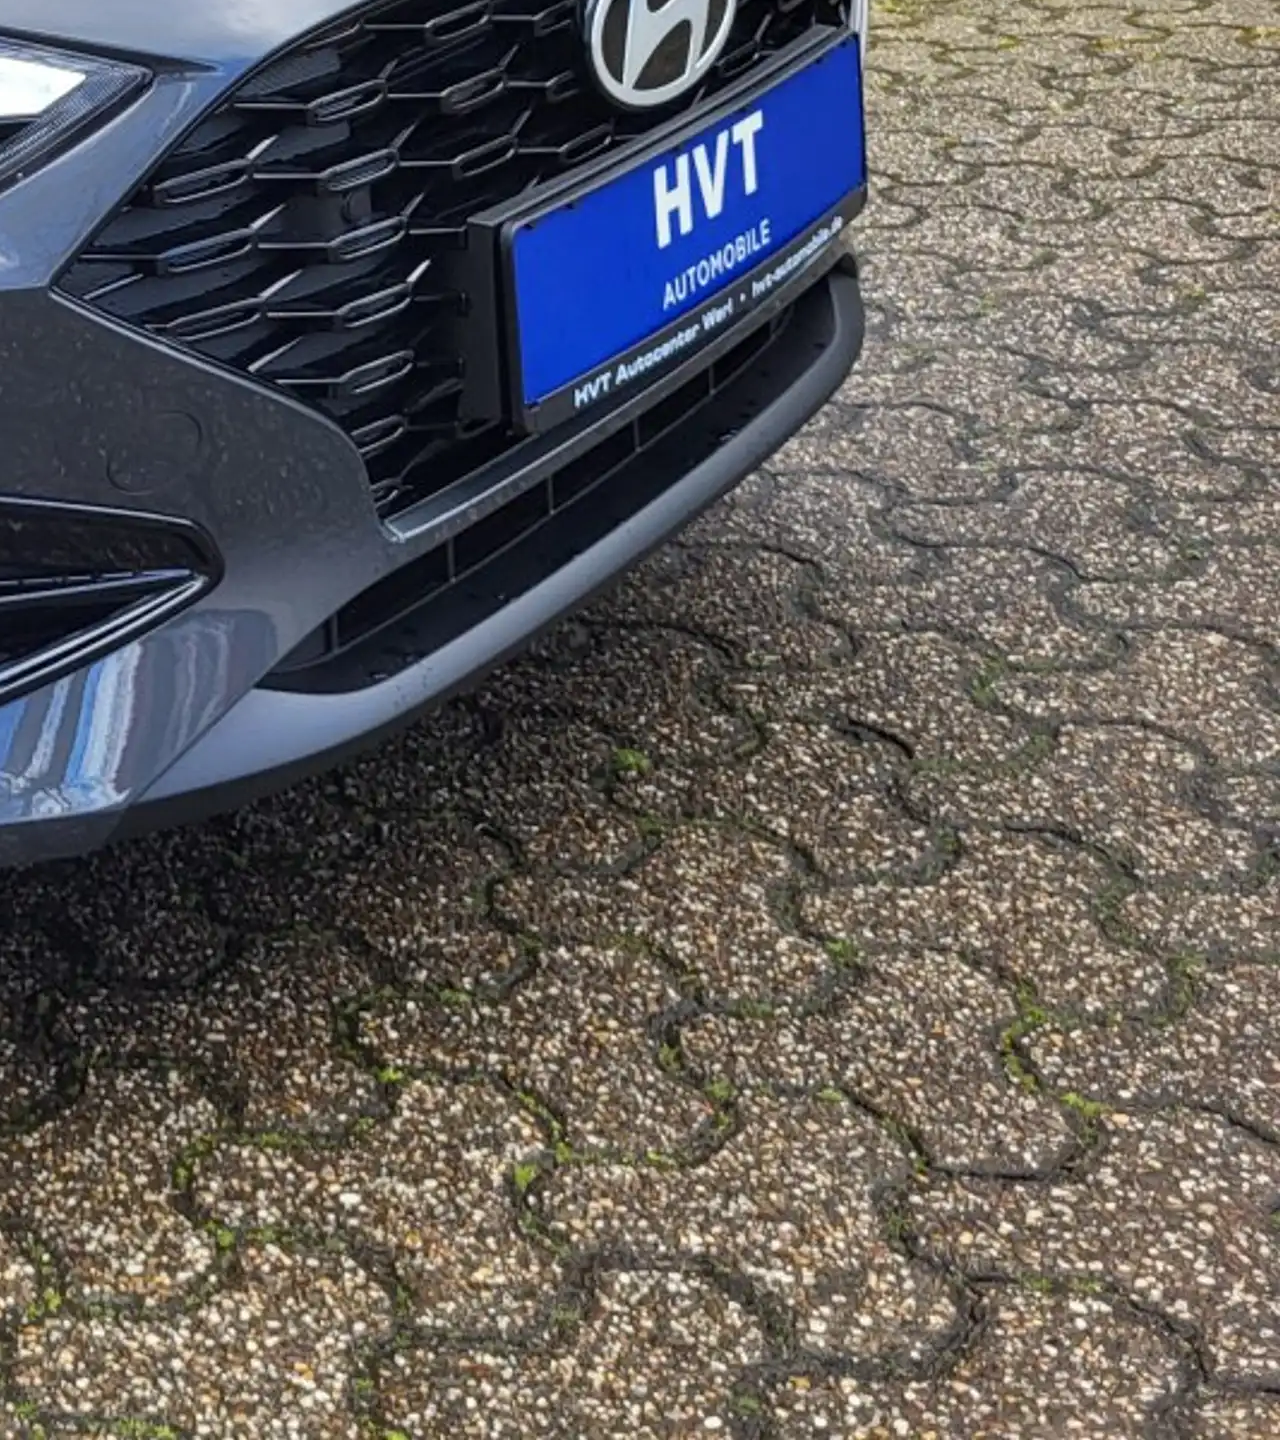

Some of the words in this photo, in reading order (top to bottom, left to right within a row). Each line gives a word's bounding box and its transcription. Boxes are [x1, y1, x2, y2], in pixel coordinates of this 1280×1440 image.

[653, 109, 764, 250] HVT
[662, 218, 772, 311] AUTOMOBILE
[574, 372, 611, 409] HVT
